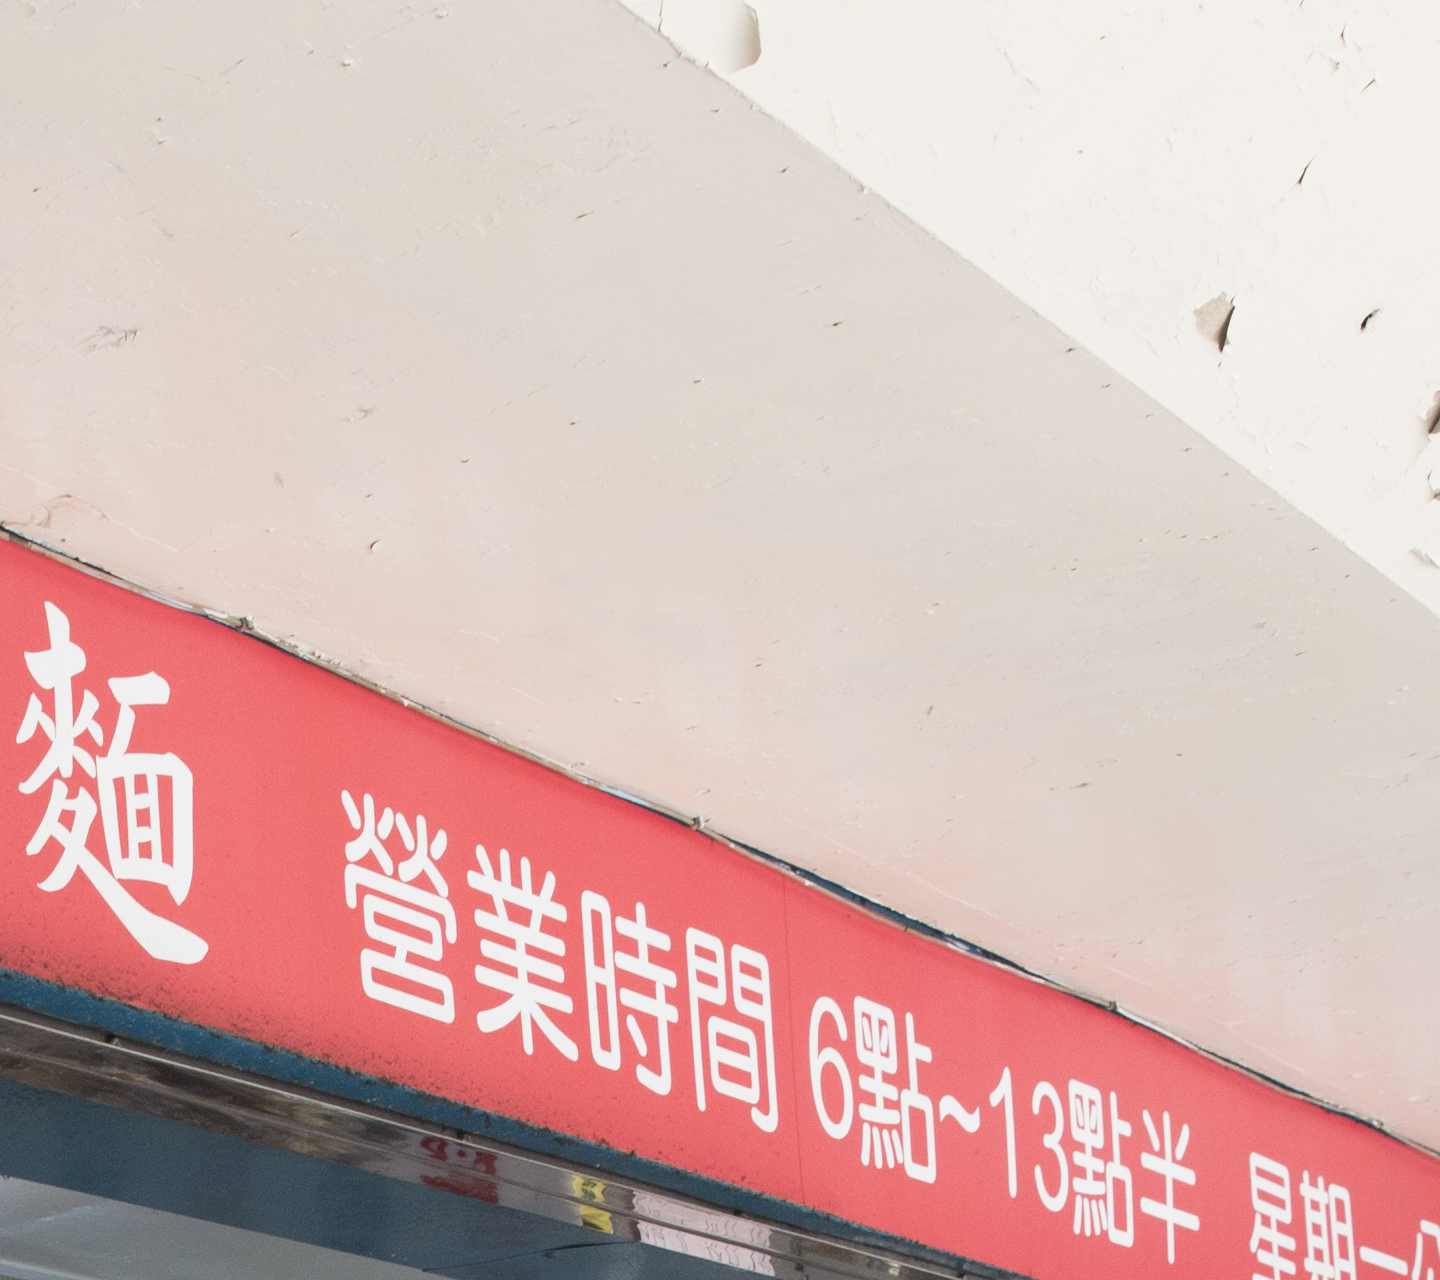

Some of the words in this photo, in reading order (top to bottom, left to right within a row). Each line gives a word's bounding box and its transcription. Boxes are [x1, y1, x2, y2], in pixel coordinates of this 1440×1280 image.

[341, 787, 778, 1132] 營業時間
[811, 994, 1200, 1262] 6點~13點半
